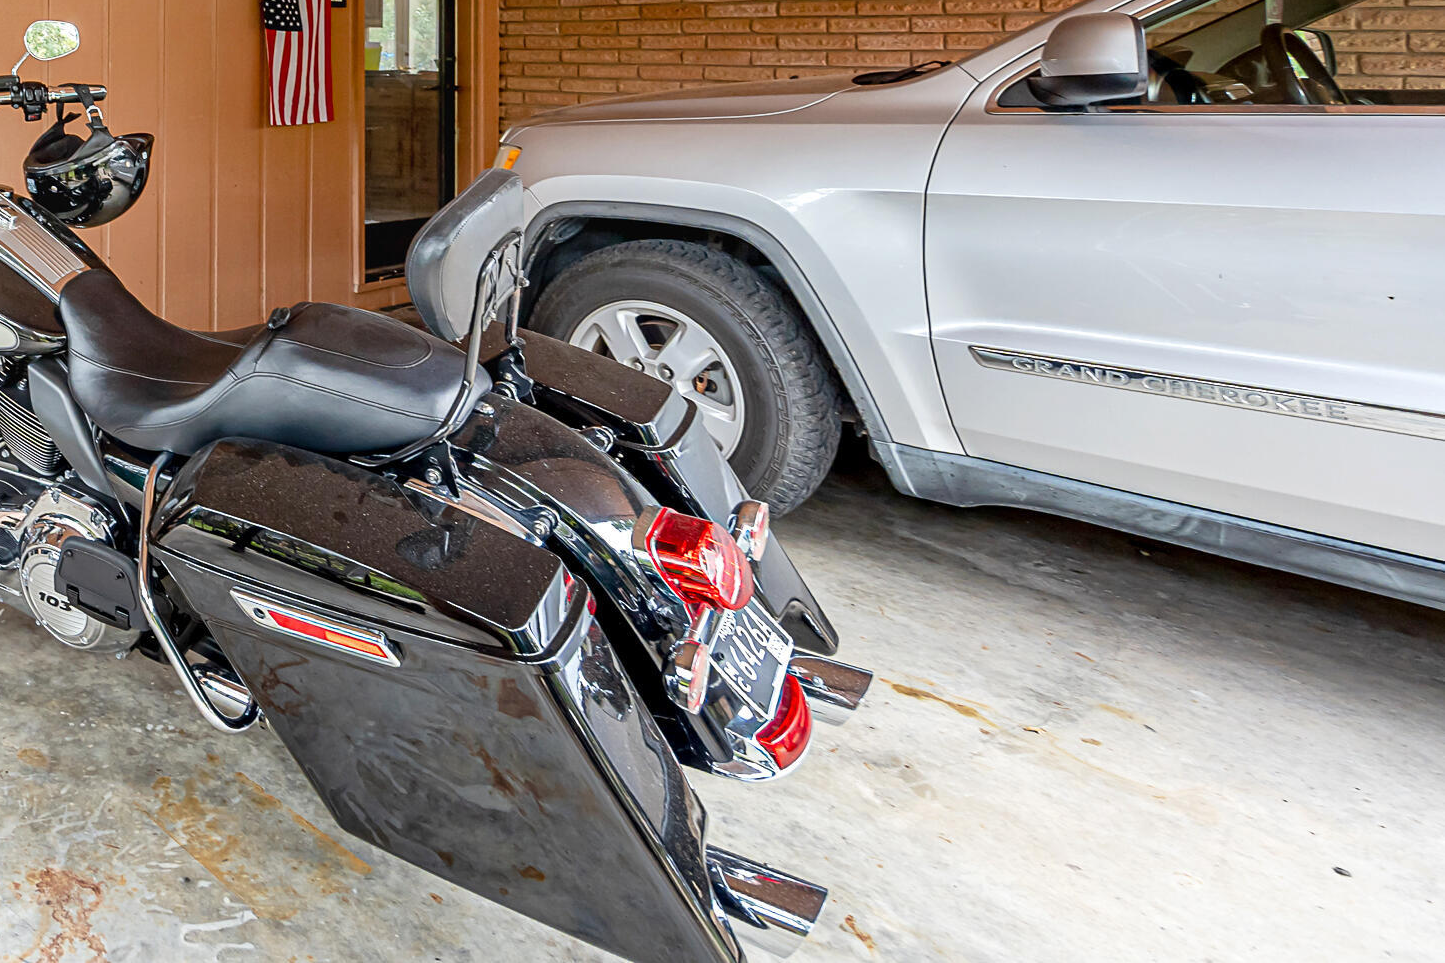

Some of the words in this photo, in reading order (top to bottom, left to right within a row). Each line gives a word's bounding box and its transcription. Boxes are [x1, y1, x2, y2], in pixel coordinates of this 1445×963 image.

[1011, 357, 1131, 387] GRAND
[1141, 376, 1349, 421] CHEROKEE
[38, 591, 72, 612] 103
